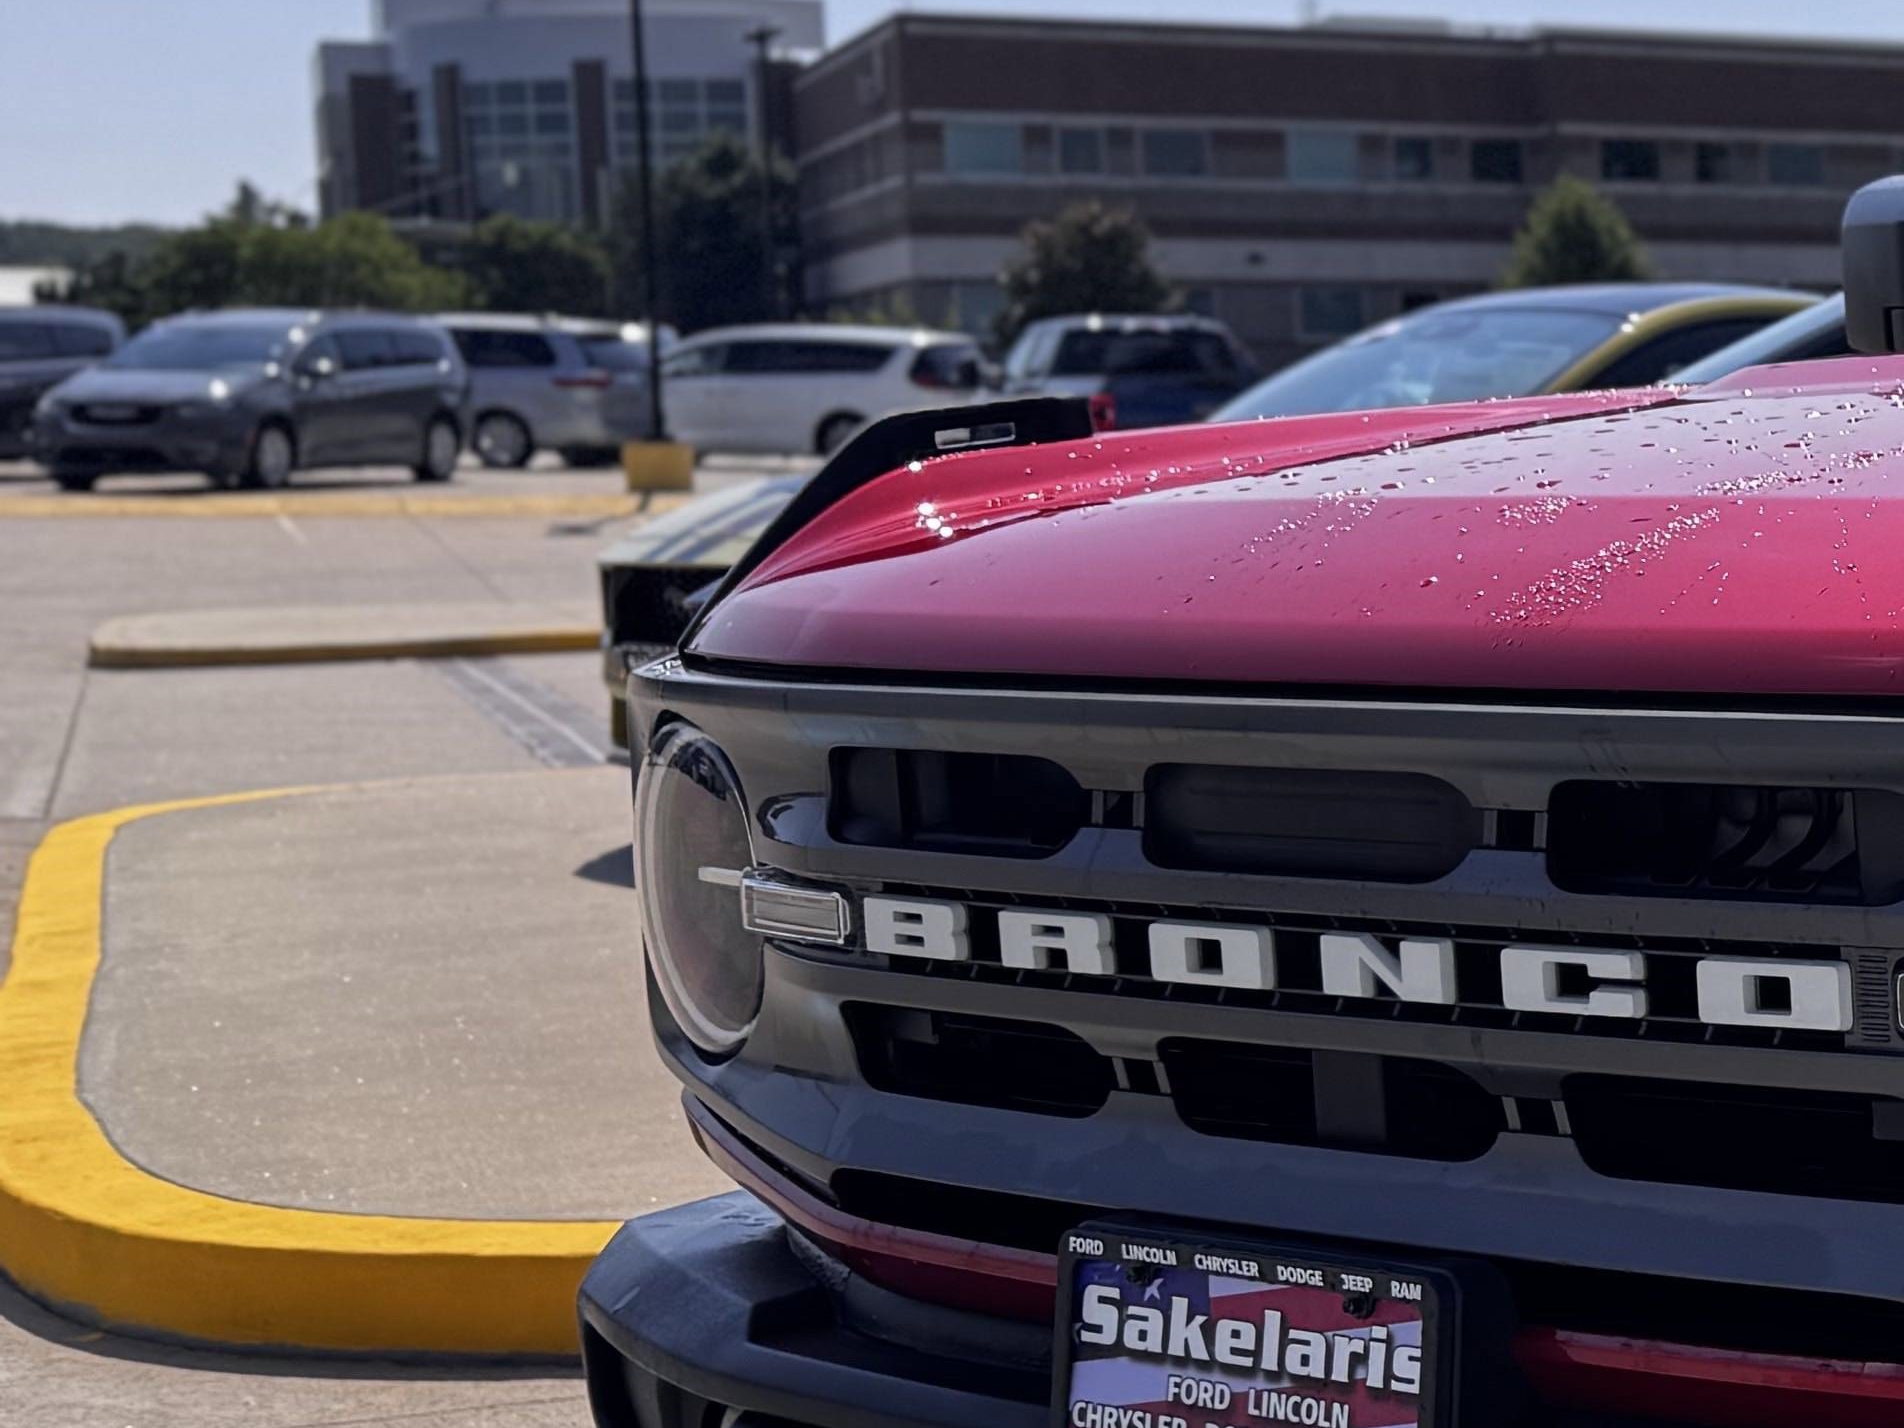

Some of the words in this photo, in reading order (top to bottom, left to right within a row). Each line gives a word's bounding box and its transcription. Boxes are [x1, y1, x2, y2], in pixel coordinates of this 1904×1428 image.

[862, 894, 1854, 1035] BRONCO
[1068, 1236, 1104, 1257] FORD
[1121, 1244, 1177, 1266] LINCOLN
[1194, 1254, 1260, 1278] CHRYSLER
[1276, 1265, 1324, 1287] DODGE
[1340, 1273, 1374, 1293] JEEP
[1390, 1280, 1422, 1301] RAM
[1080, 1284, 1423, 1396] Sakelaris
[1167, 1375, 1231, 1412] FORD
